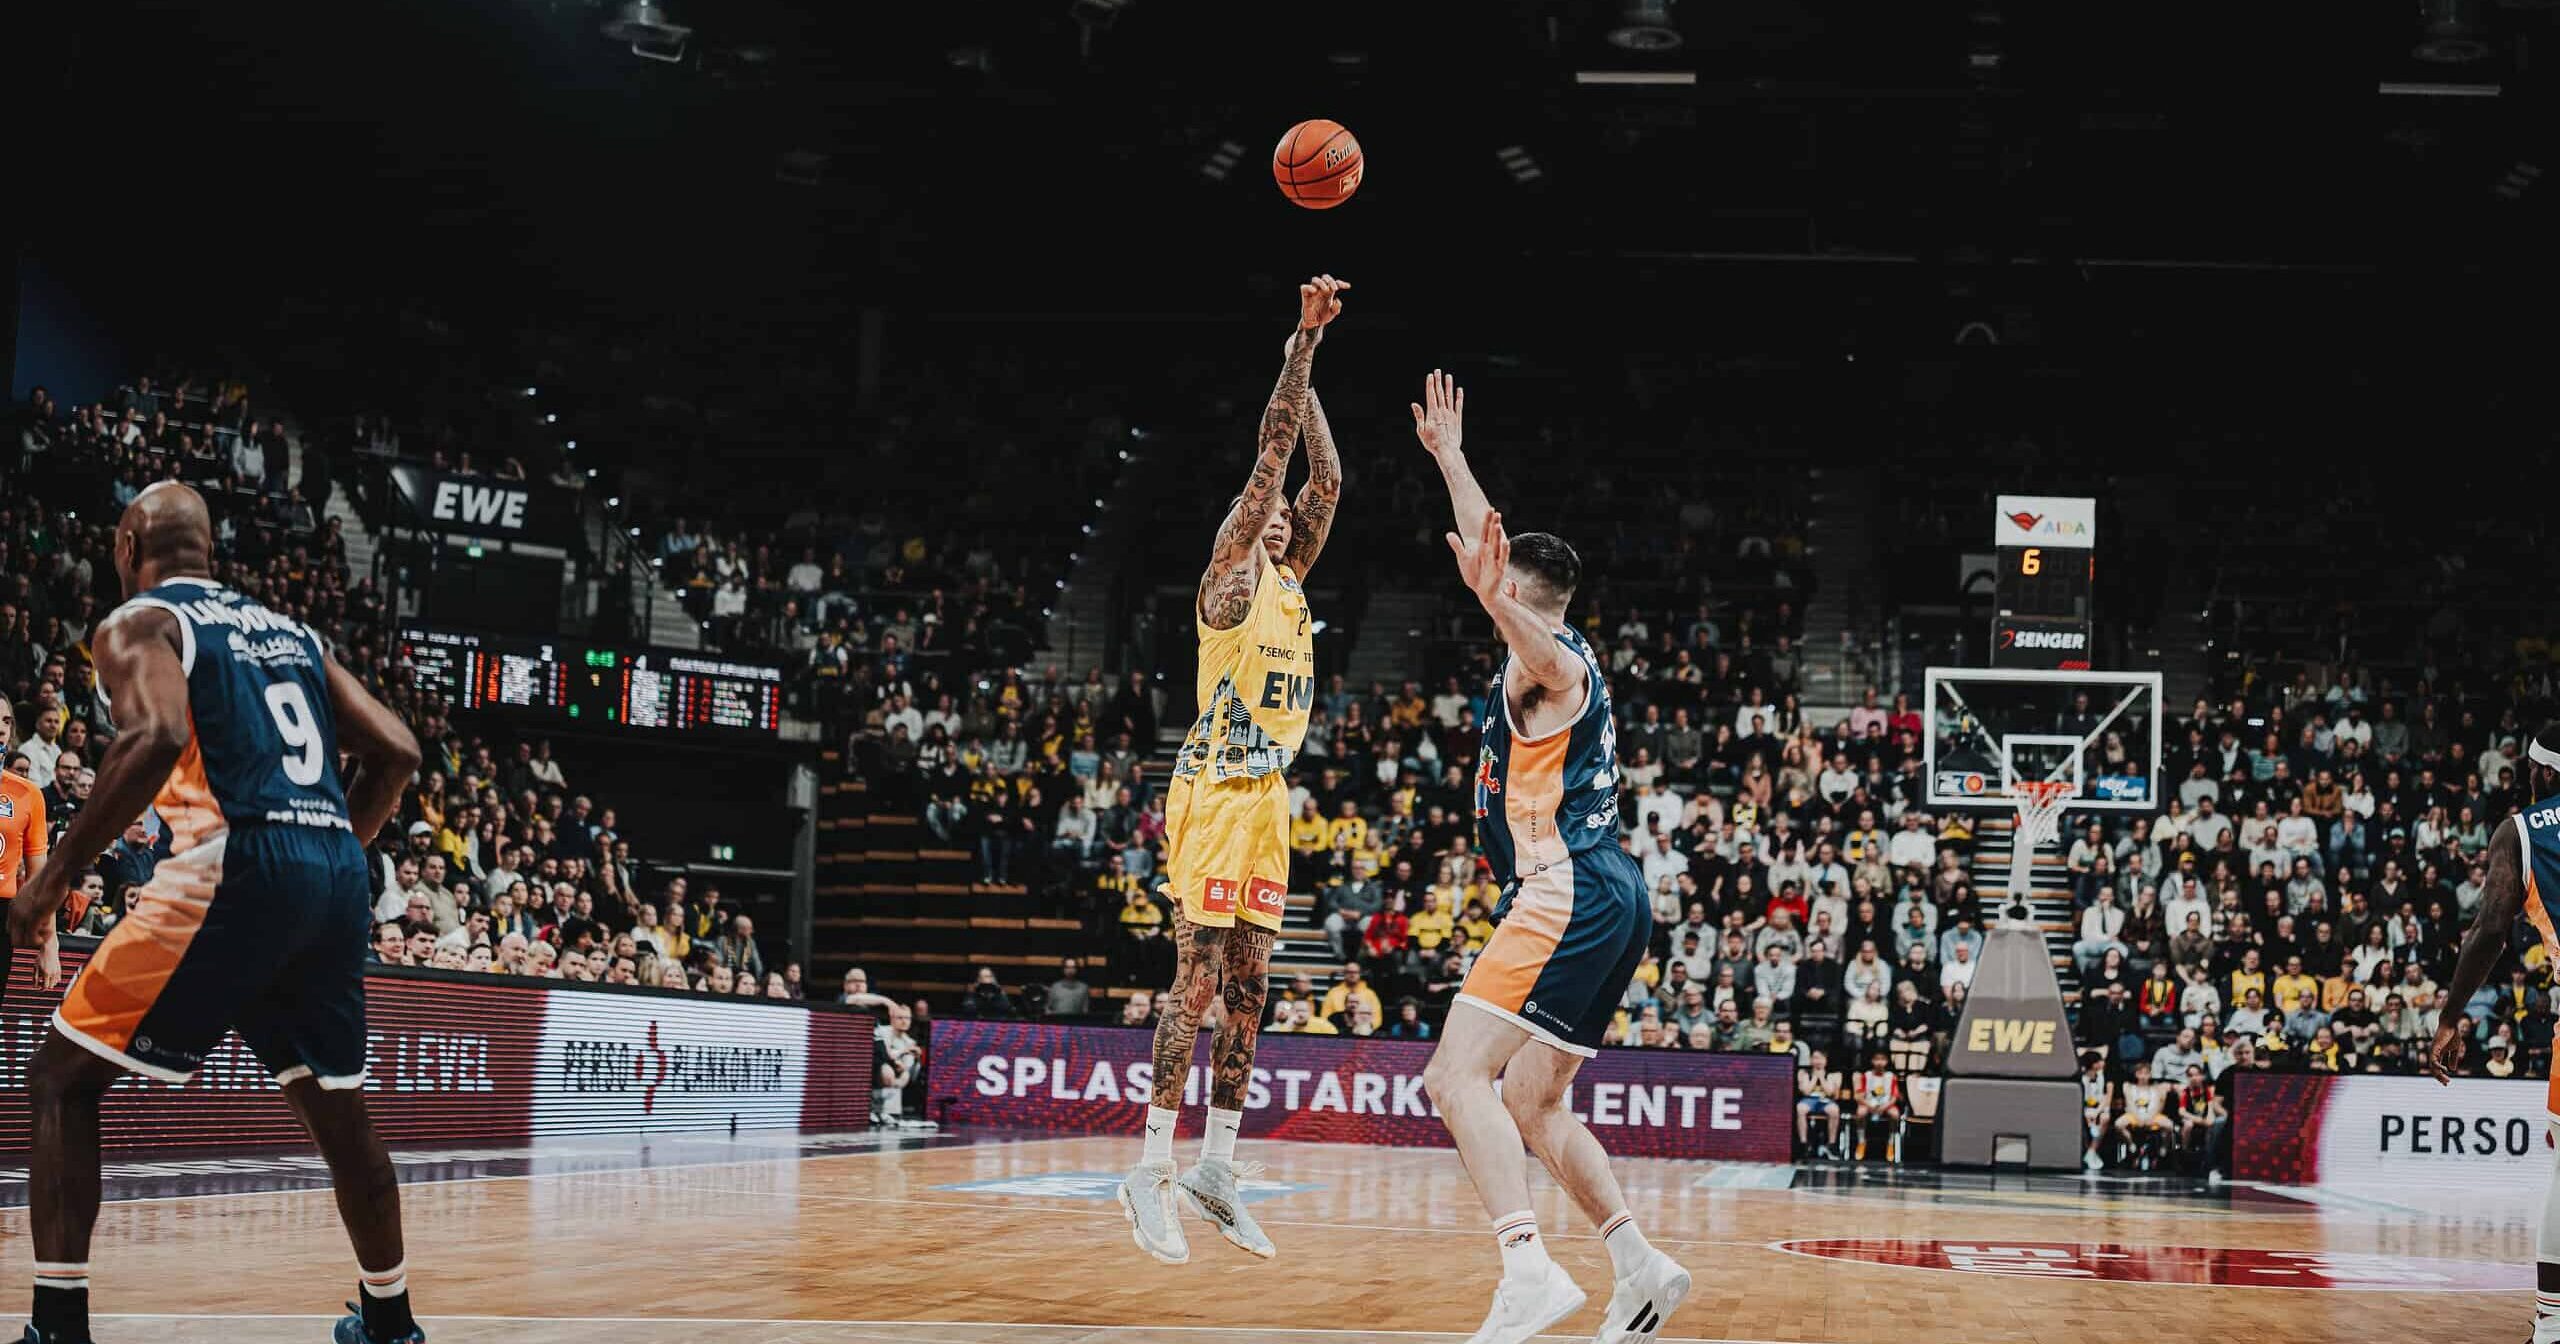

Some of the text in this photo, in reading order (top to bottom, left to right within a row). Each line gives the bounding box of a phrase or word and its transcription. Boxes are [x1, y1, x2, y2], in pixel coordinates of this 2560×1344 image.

[432, 481, 528, 529] EWE
[2043, 520, 2086, 535] AIDA
[2022, 549, 2041, 576] 6
[2014, 631, 2086, 650] SENGER
[264, 680, 324, 786] 9
[1967, 1018, 2057, 1055] EWE
[395, 1030, 494, 1091] LEVEL
[562, 1040, 629, 1092] PERSO
[1243, 1066, 1441, 1118] STARK
[2379, 1115, 2530, 1156] PERSO
